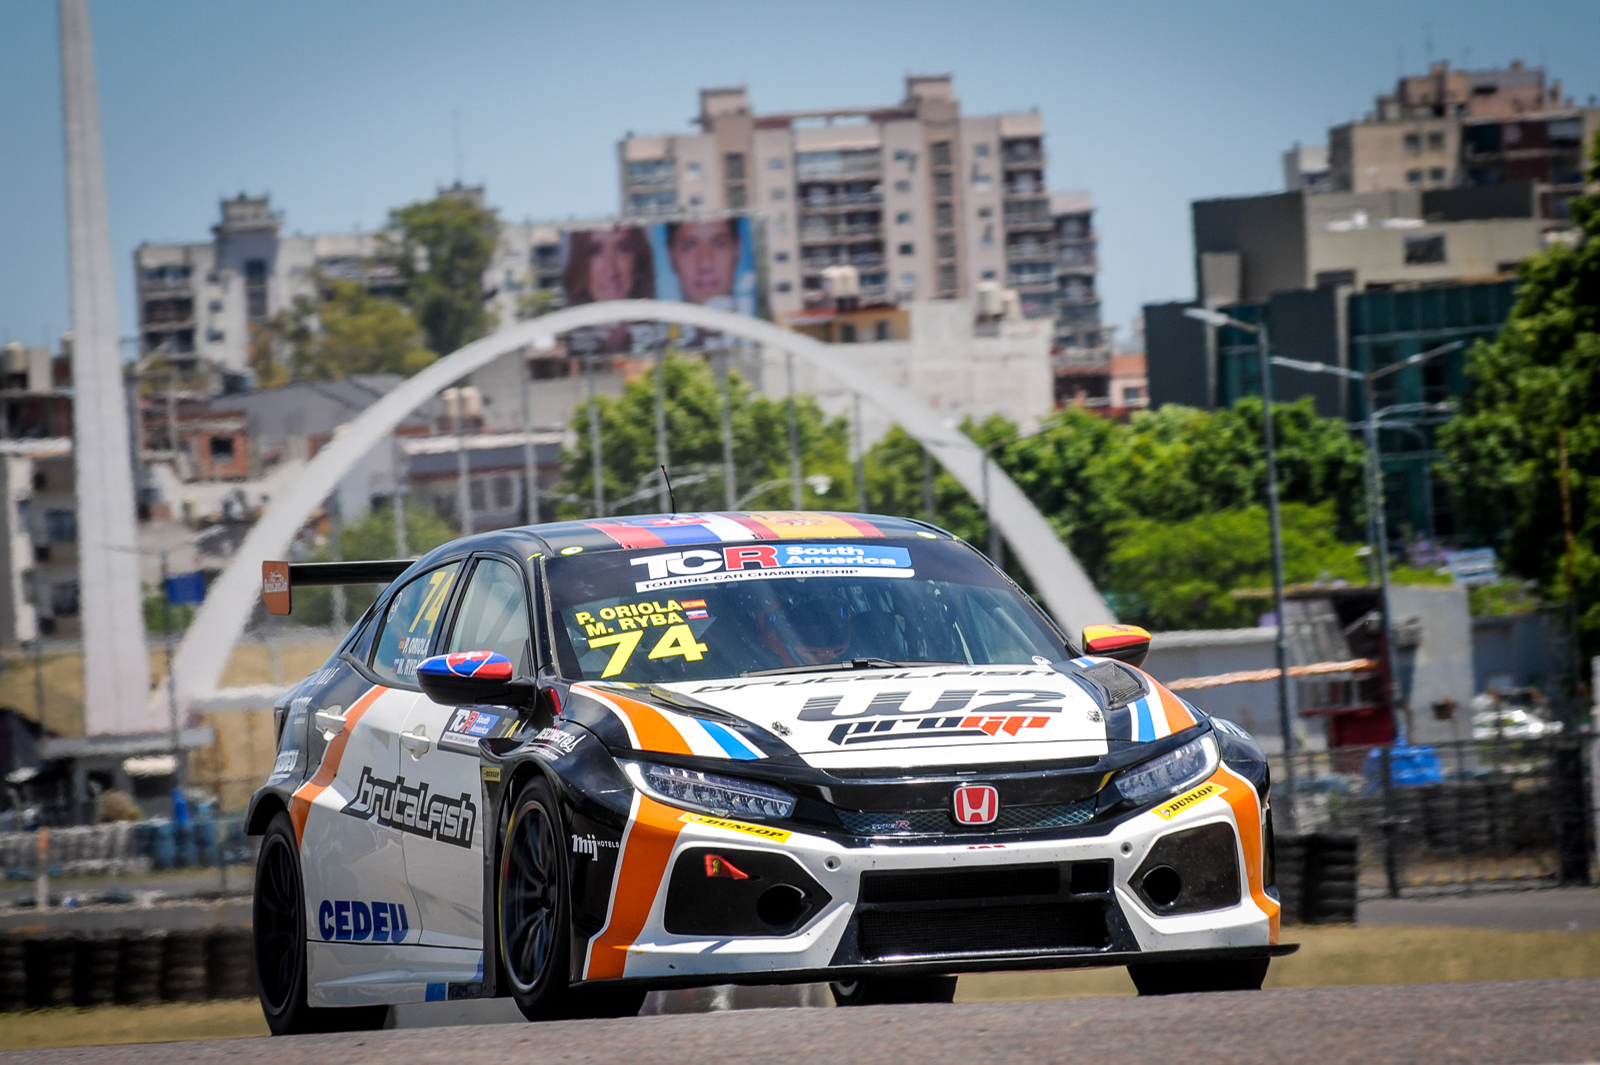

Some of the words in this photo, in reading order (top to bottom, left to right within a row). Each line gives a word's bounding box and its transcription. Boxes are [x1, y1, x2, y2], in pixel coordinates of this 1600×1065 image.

[630, 545, 781, 579] TCR
[786, 546, 864, 555] South
[786, 555, 896, 565] America
[644, 577, 709, 589] TOURING
[748, 569, 858, 577] CHAMPIONSHIP
[408, 572, 456, 634] 74
[575, 611, 595, 625] P.
[600, 599, 683, 620] ORIOLA
[585, 622, 614, 637] M.
[618, 612, 685, 630] RYBA
[588, 624, 709, 679] 74
[449, 709, 480, 734] TCR
[1169, 785, 1213, 811] DUNLOP
[704, 819, 784, 838] DUNLOP
[597, 840, 620, 848] HOTELS
[318, 900, 409, 943] CEDEU
